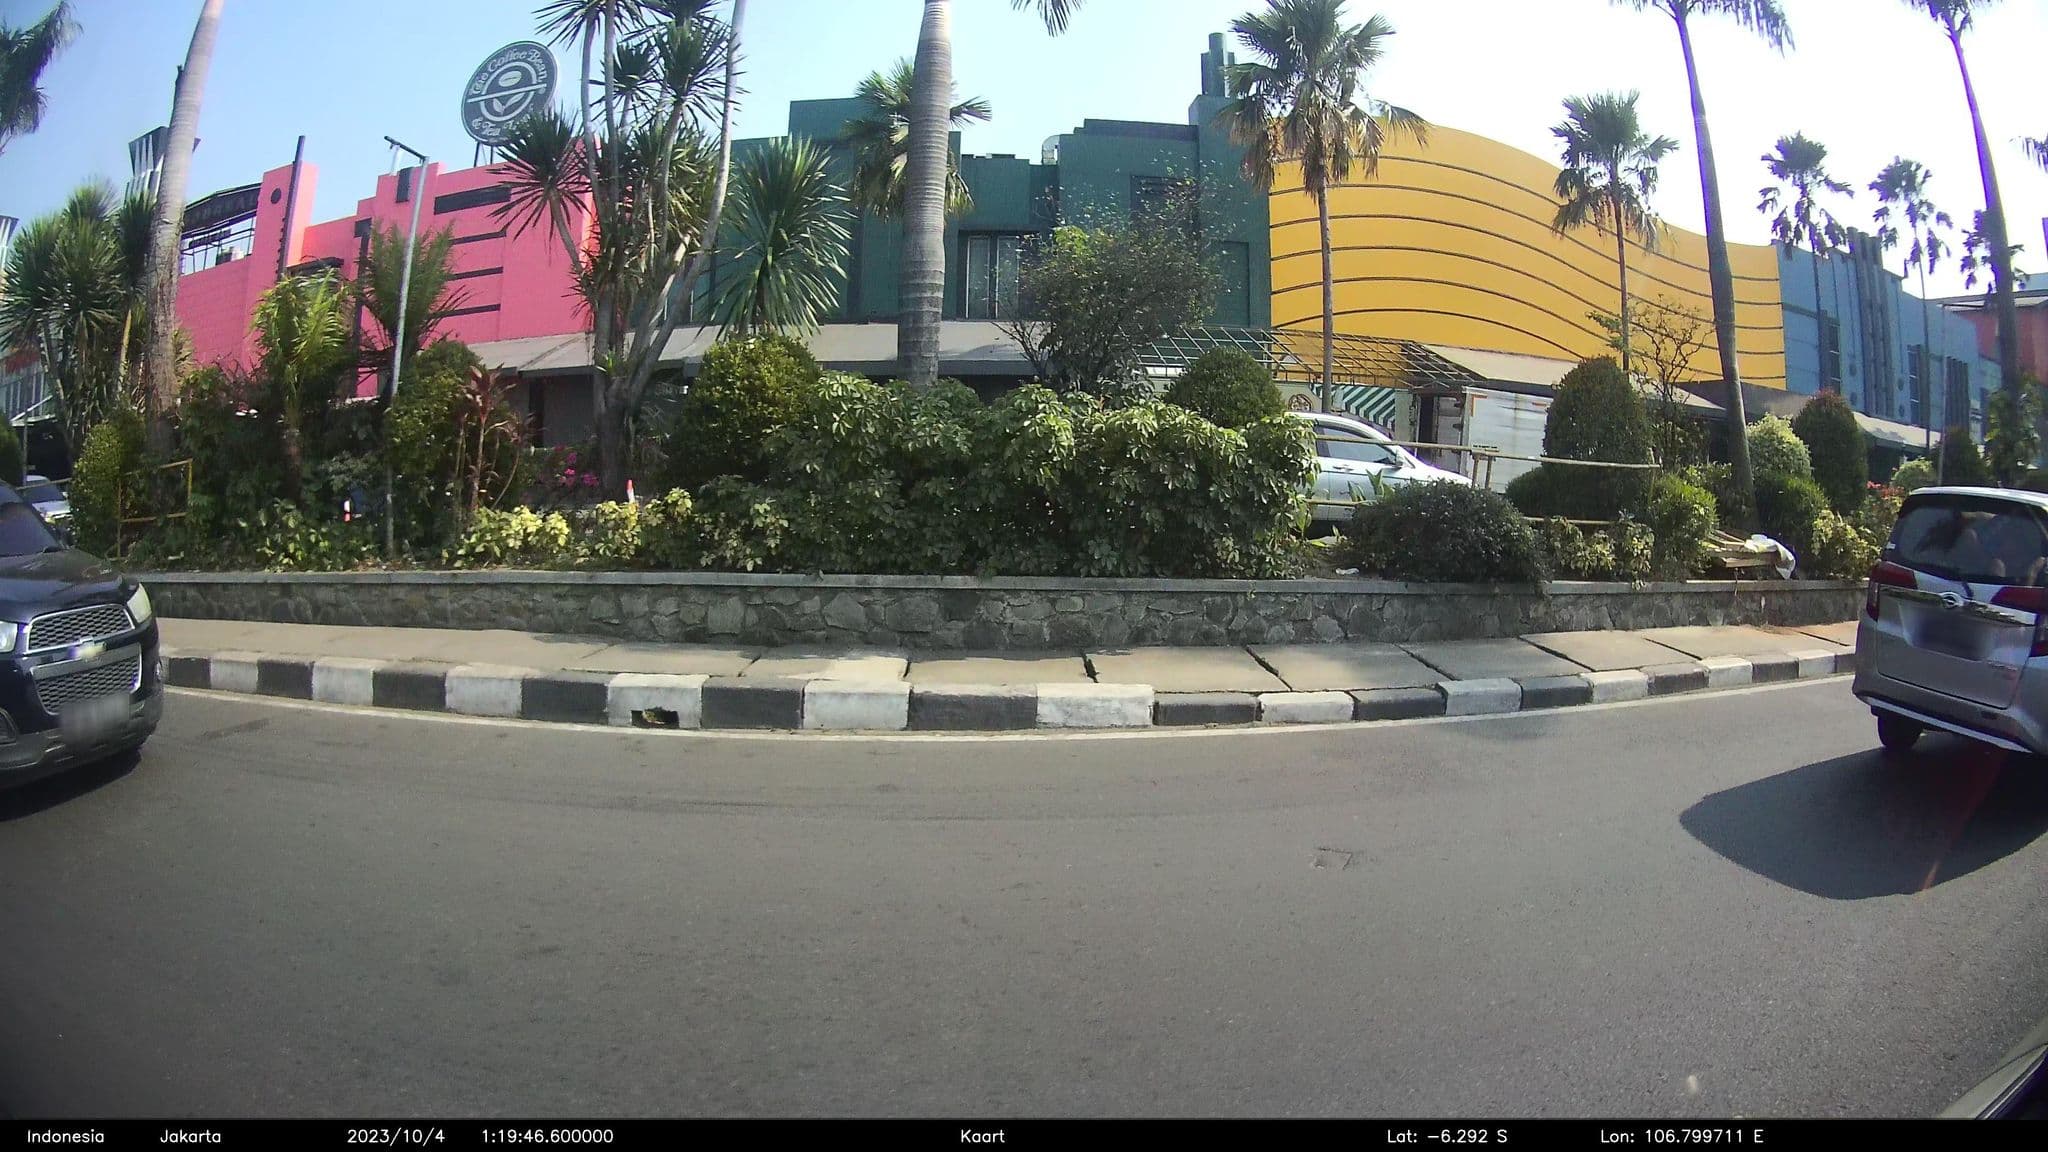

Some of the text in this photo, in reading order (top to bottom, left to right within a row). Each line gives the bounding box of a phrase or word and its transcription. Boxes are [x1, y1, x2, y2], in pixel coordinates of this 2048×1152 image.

[469, 49, 547, 95] The Coffee Bean
[482, 121, 501, 136] Tea
